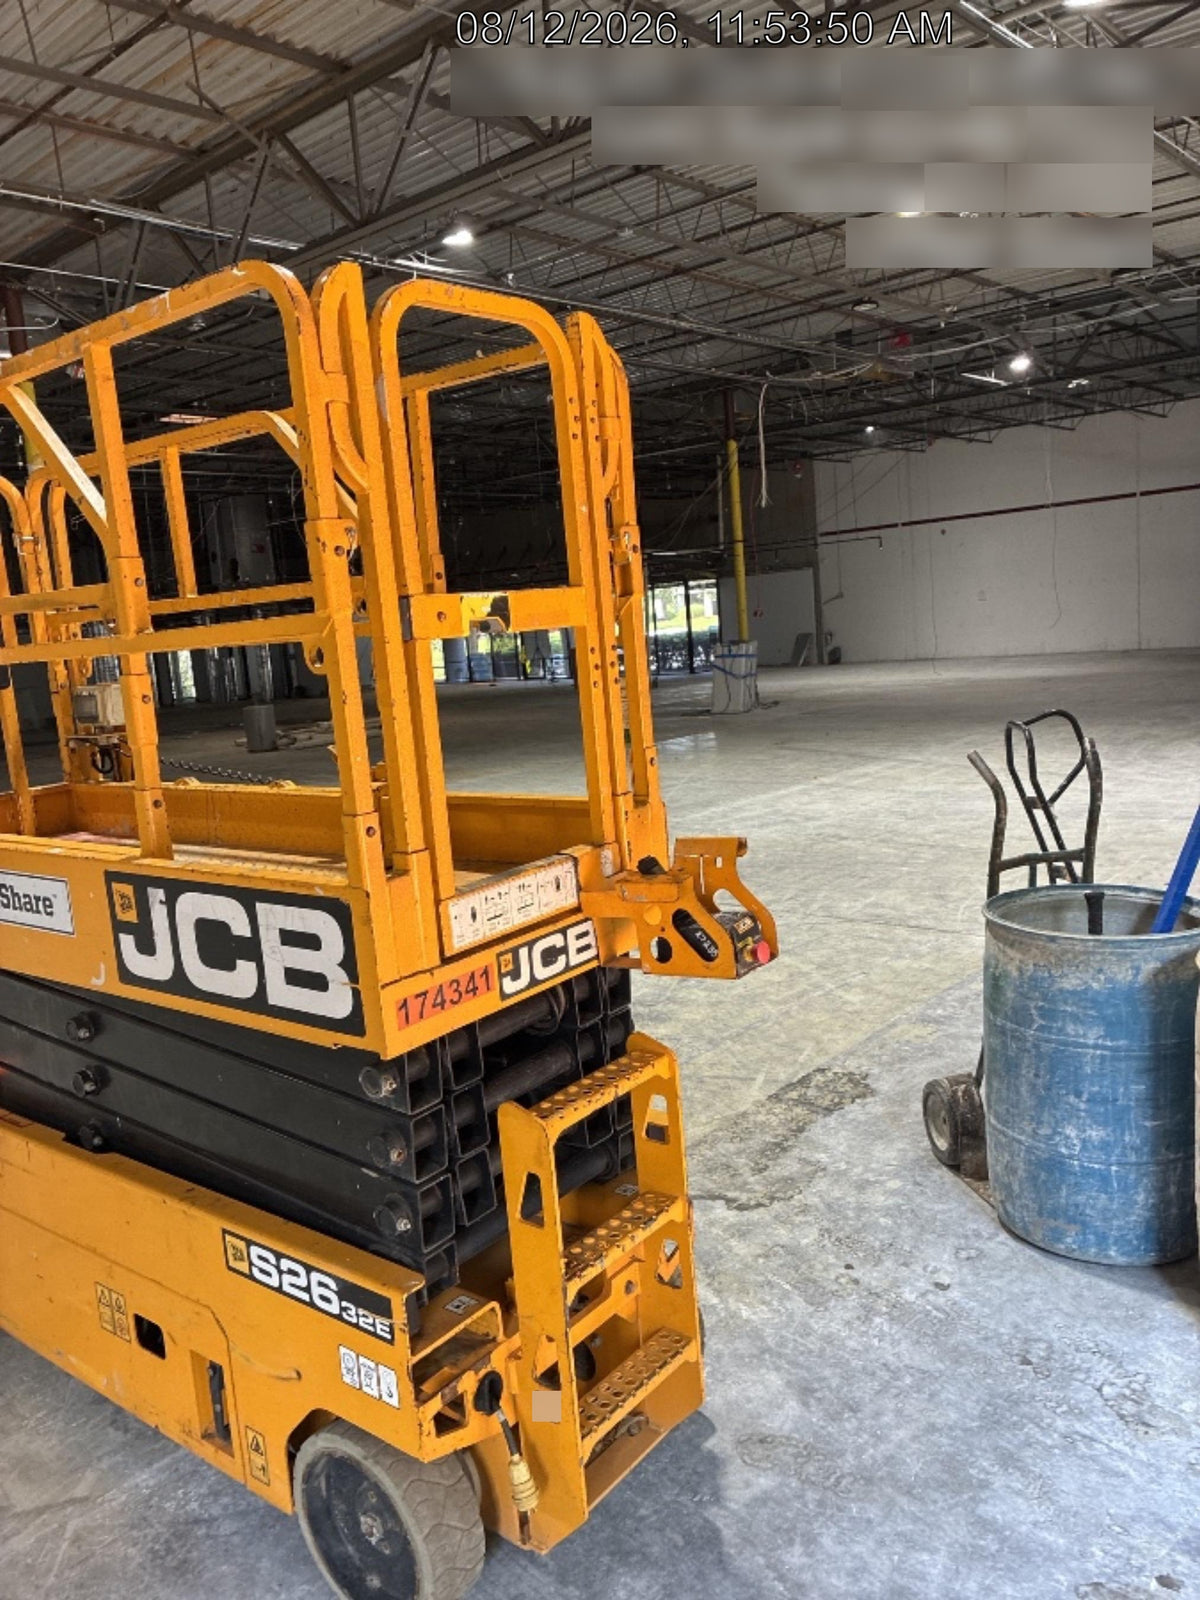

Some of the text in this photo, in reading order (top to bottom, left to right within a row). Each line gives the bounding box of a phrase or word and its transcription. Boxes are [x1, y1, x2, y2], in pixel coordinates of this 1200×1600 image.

[0, 883, 54, 917] Share
[119, 886, 354, 1020] JCB
[502, 920, 598, 995] JCB
[398, 965, 492, 1026] 174341
